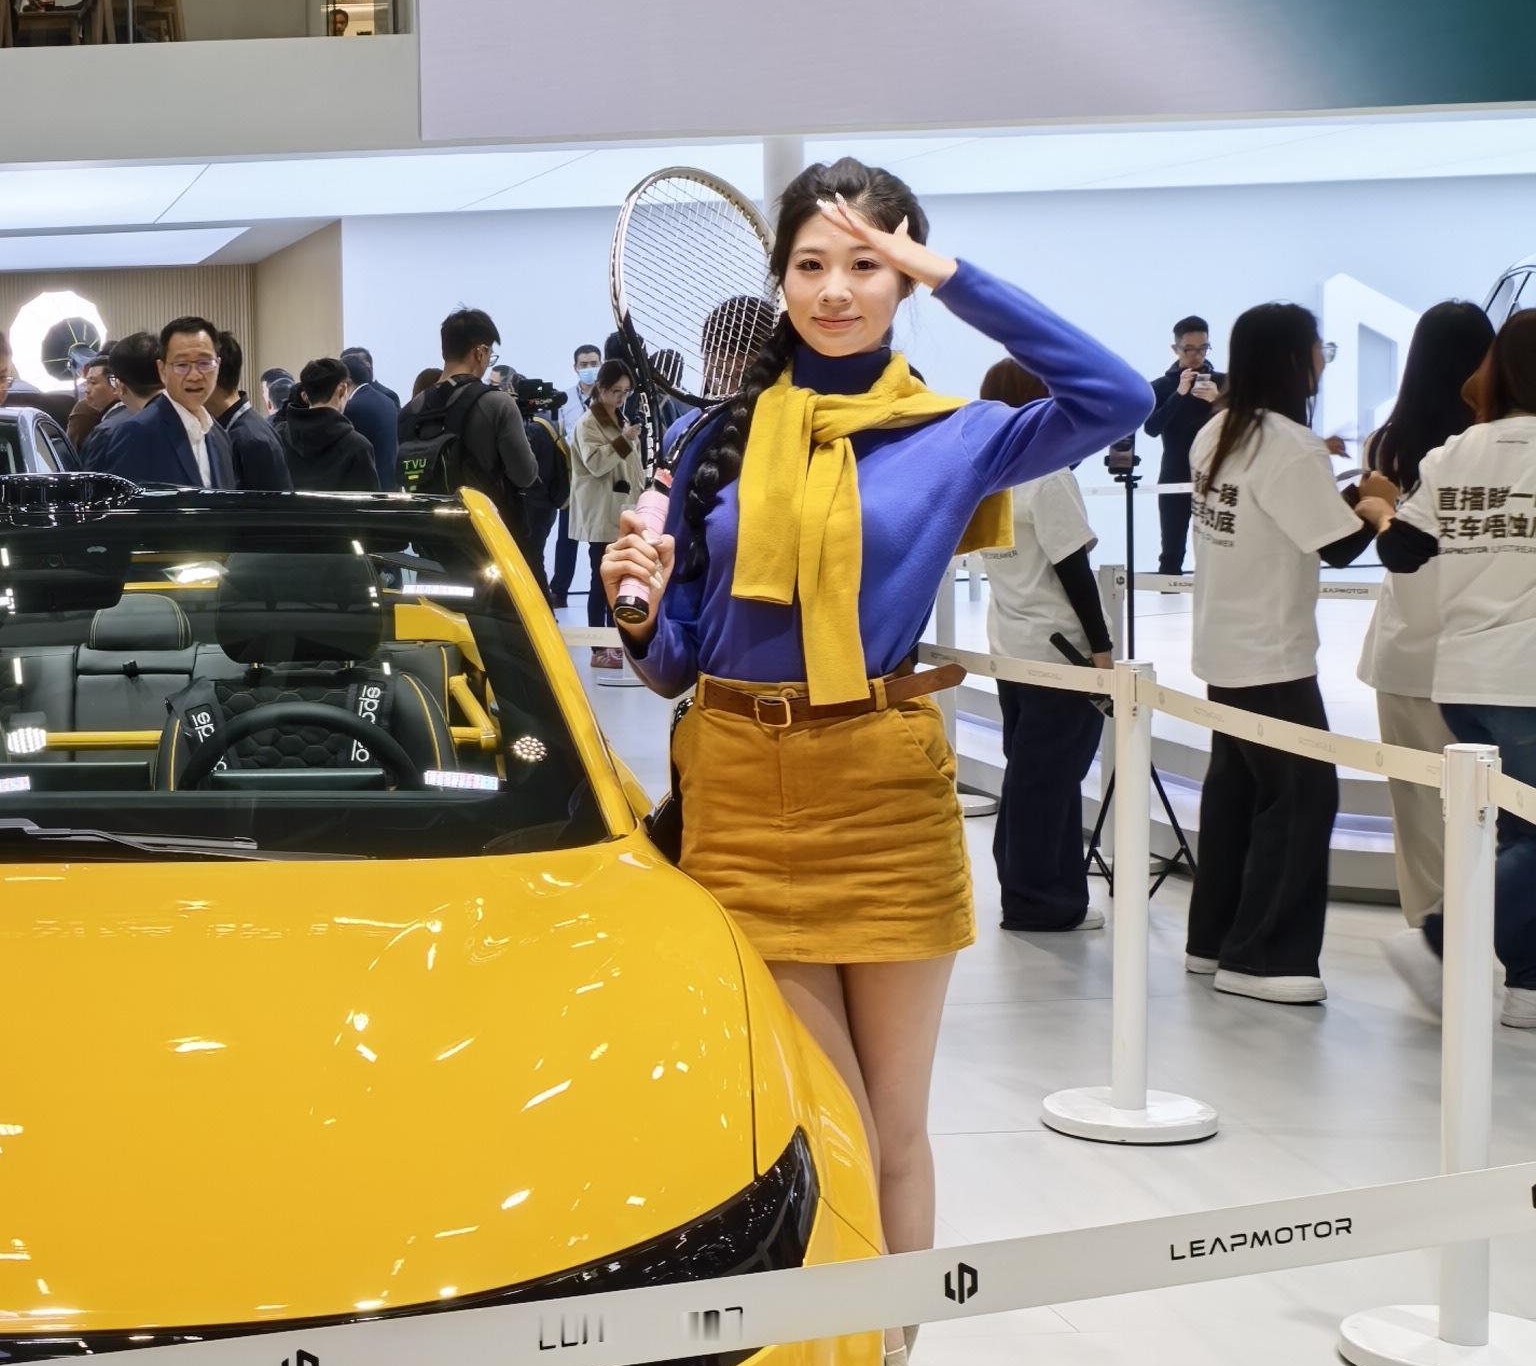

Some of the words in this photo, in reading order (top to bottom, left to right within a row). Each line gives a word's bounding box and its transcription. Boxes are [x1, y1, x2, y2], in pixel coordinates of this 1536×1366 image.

[1437, 486, 1536, 511] 直播睇一
[1170, 1217, 1353, 1262] LEAPMOTOR
